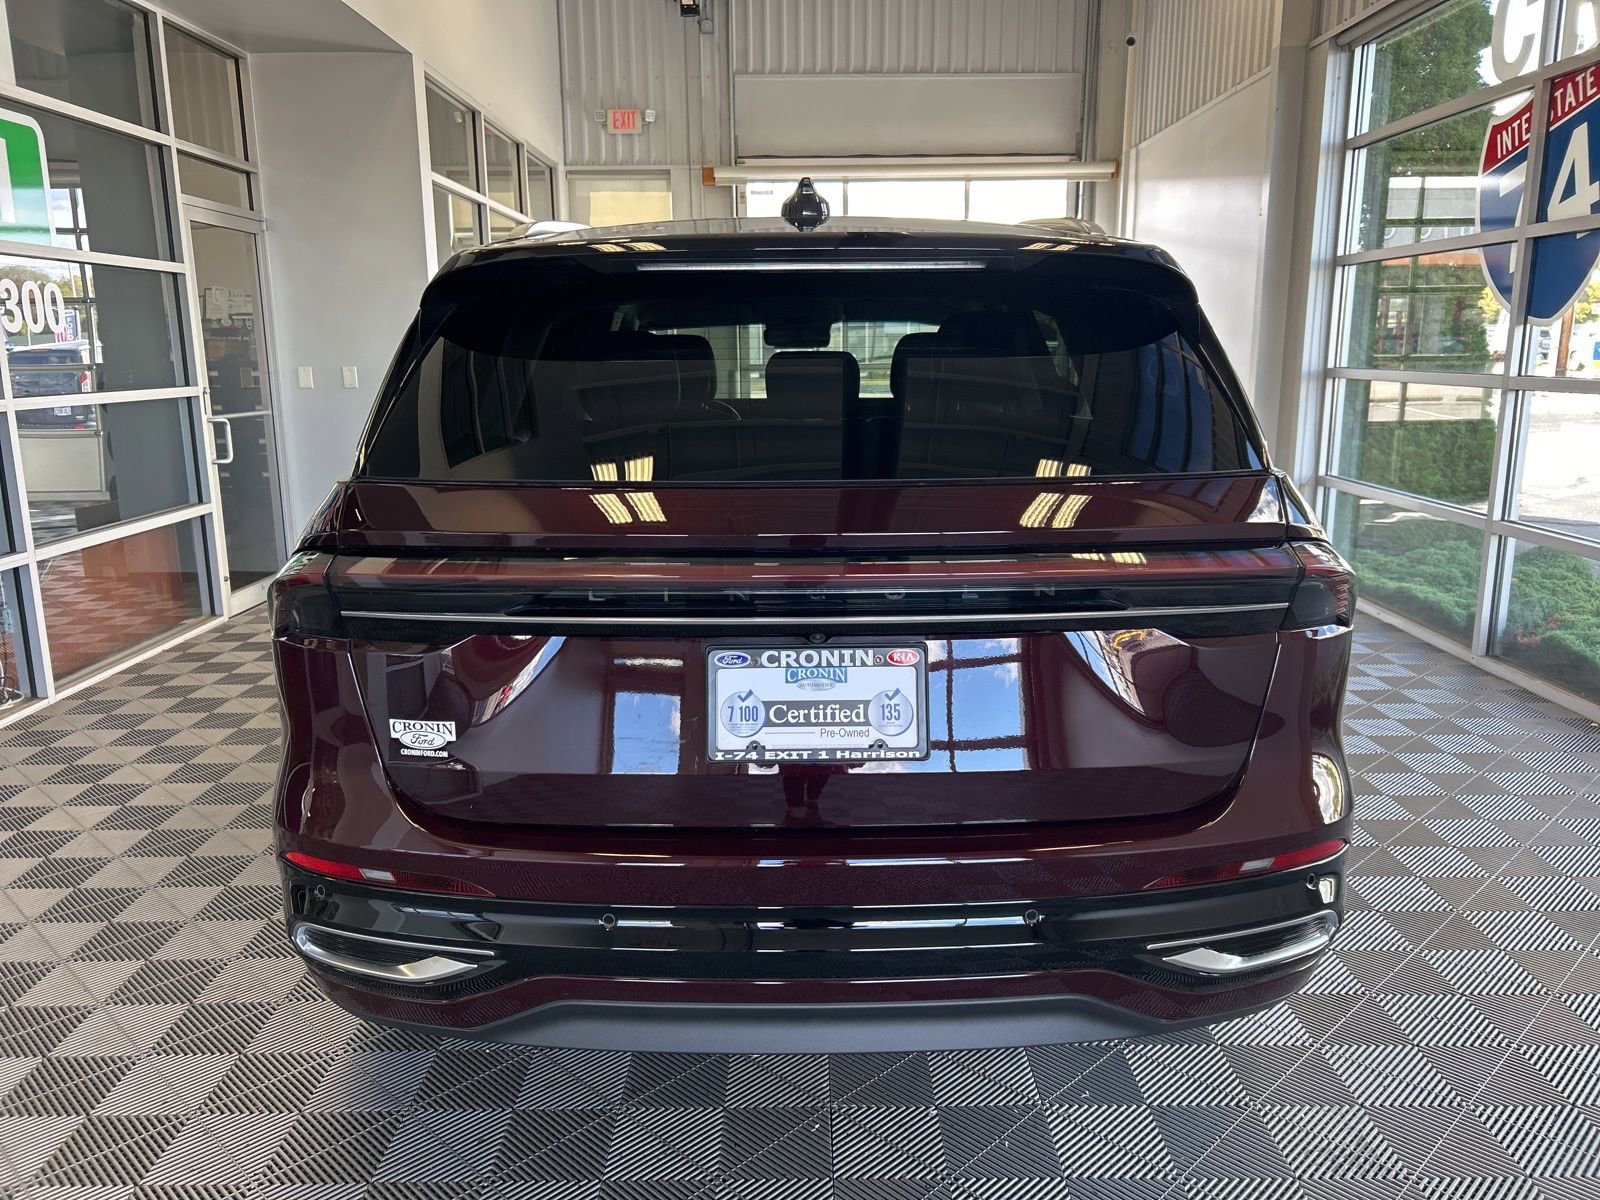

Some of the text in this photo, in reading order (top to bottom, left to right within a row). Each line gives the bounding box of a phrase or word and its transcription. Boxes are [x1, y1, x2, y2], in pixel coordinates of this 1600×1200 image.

[613, 110, 636, 129] EXIT
[1497, 66, 1598, 159] INTETATE
[722, 649, 915, 667] Ford CRONIN KIA
[787, 667, 845, 682] CRONIN
[769, 704, 866, 724] Certified
[880, 703, 901, 721] 135
[392, 721, 453, 737] CRONIN
[820, 727, 870, 738] Pre-Owned
[410, 733, 435, 746] Ford
[400, 748, 449, 758] CRONINFORD.COM
[715, 749, 921, 760] I-74 EXIT 1 Harrison
